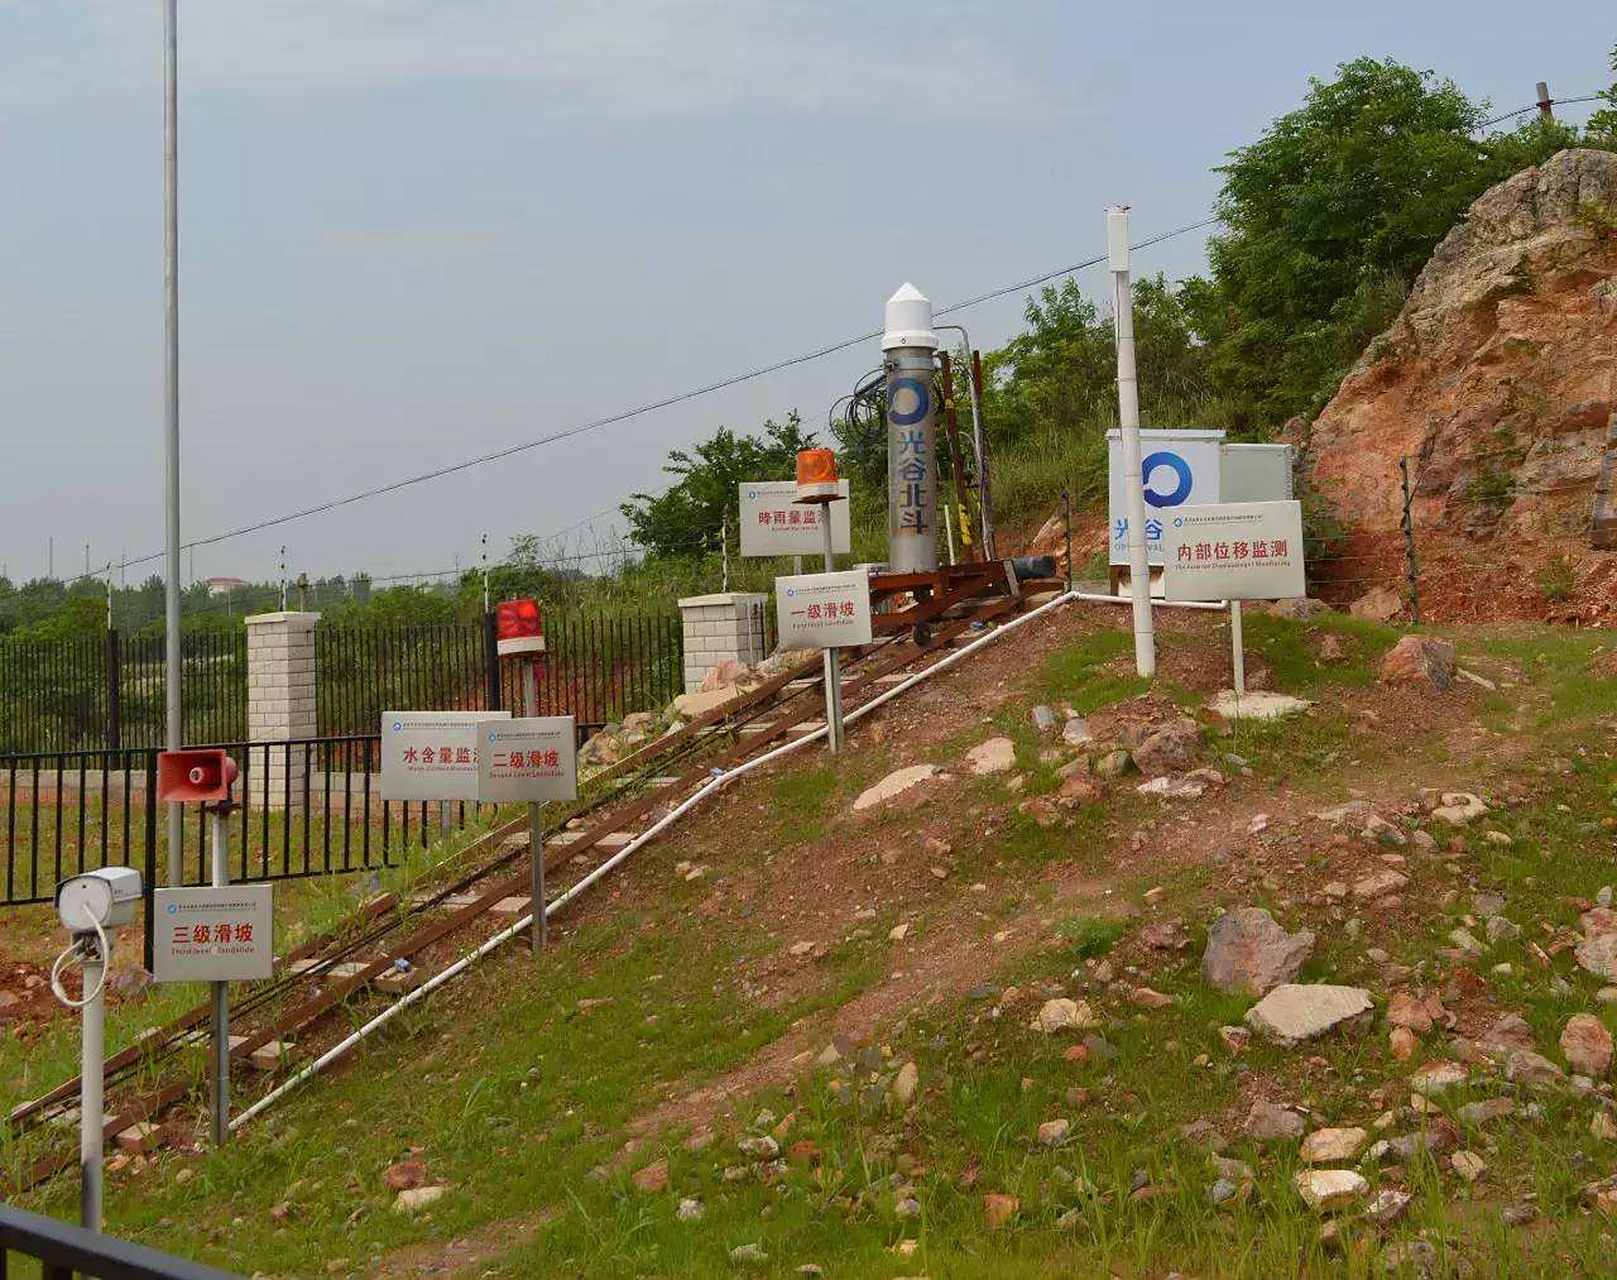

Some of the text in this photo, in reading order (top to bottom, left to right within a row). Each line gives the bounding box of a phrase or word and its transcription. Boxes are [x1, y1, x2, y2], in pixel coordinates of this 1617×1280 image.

[897, 432, 927, 534] 光谷北斗
[1177, 539, 1289, 561] 内部位移监测
[791, 600, 855, 619] 一级滑坡
[493, 748, 560, 768] 二级滑坡
[171, 922, 254, 944] 三级滑坡
